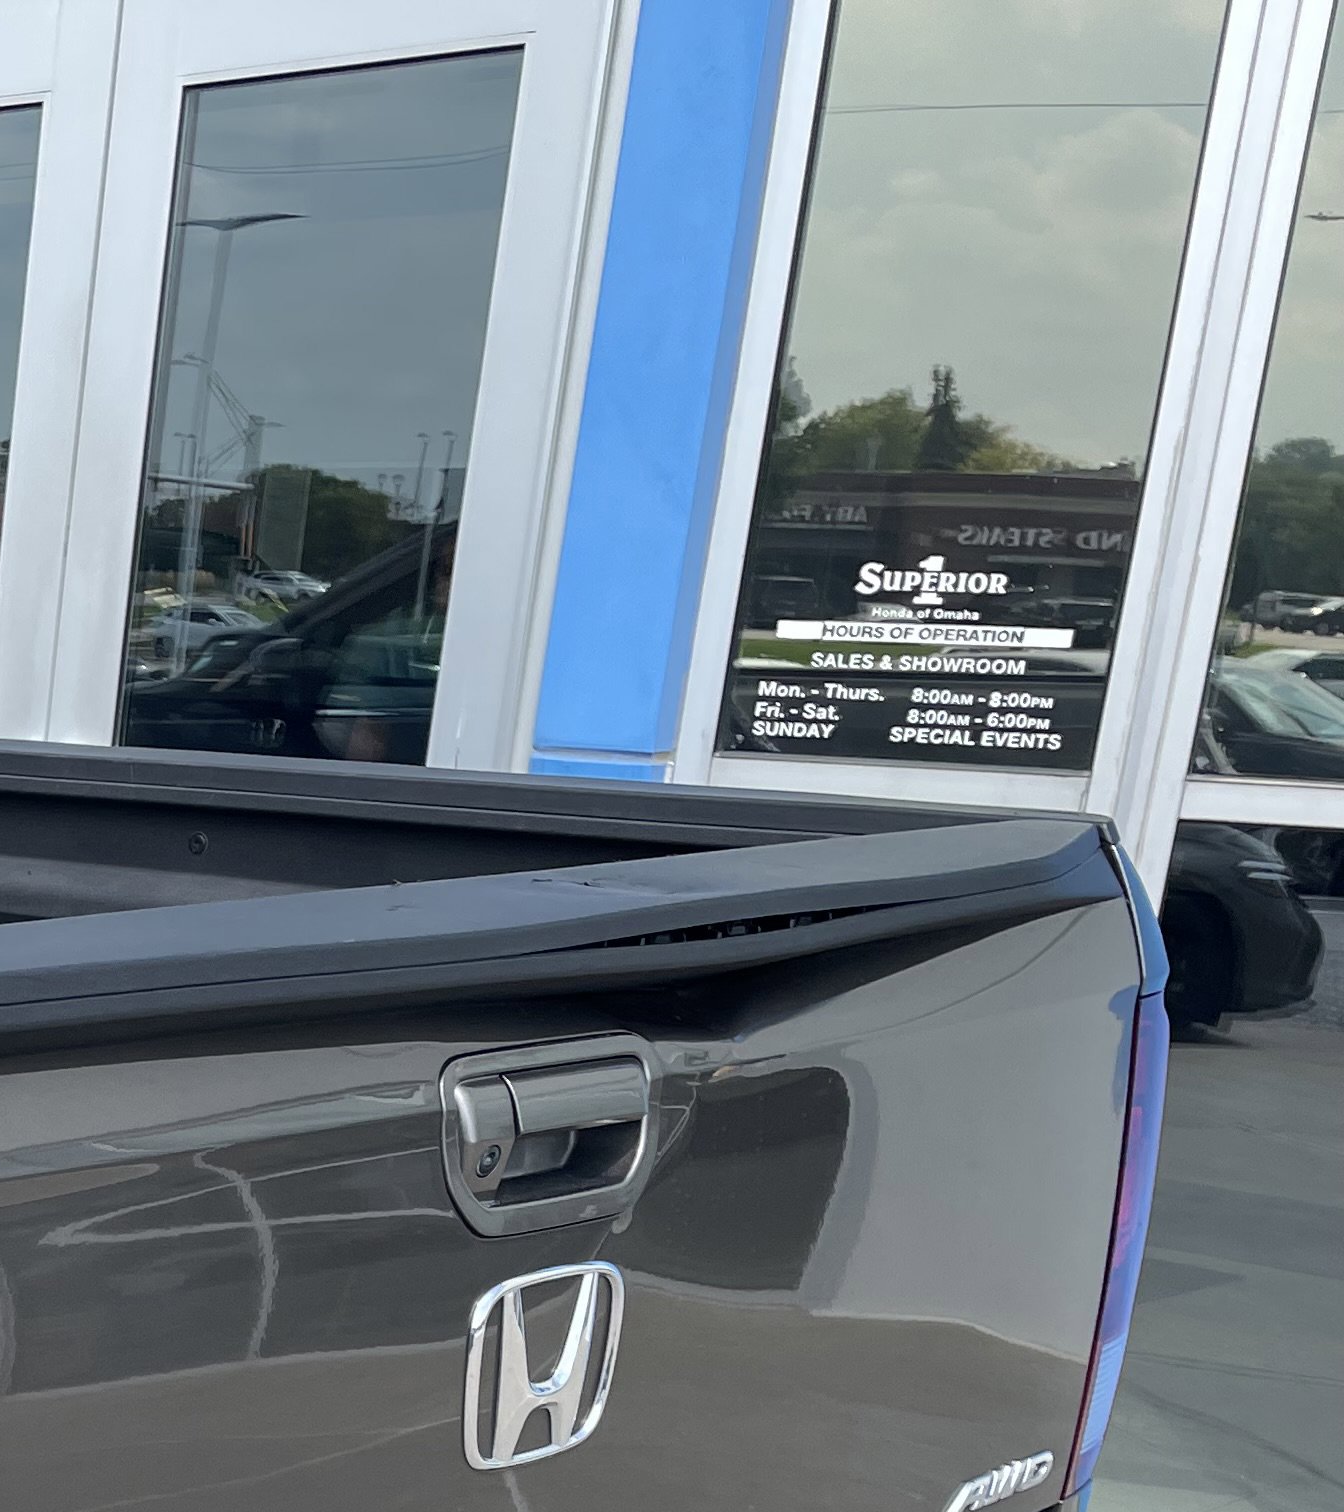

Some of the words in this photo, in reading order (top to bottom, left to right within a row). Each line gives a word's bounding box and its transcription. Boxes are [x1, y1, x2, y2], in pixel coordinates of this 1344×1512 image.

[854, 562, 1008, 595] SUPERIOR
[871, 607, 914, 619] Honda
[916, 608, 932, 619] of
[933, 608, 980, 621] Omaha
[823, 624, 885, 639] HOURS
[890, 626, 915, 640] OF
[919, 627, 1025, 644] OPERATION
[811, 652, 874, 670] SALES
[879, 655, 893, 671] &
[899, 655, 1026, 676] SHOWROOM
[758, 680, 806, 699] Mon.
[824, 682, 885, 702] Thurs.
[911, 687, 974, 706] 8:00AM
[989, 691, 1054, 709] 8:00PM
[754, 701, 785, 719] Fri.
[802, 703, 840, 721] Sat.
[752, 720, 835, 739] SUNDAY
[889, 726, 976, 746] SPECIAL
[980, 730, 1062, 750] EVENTS
